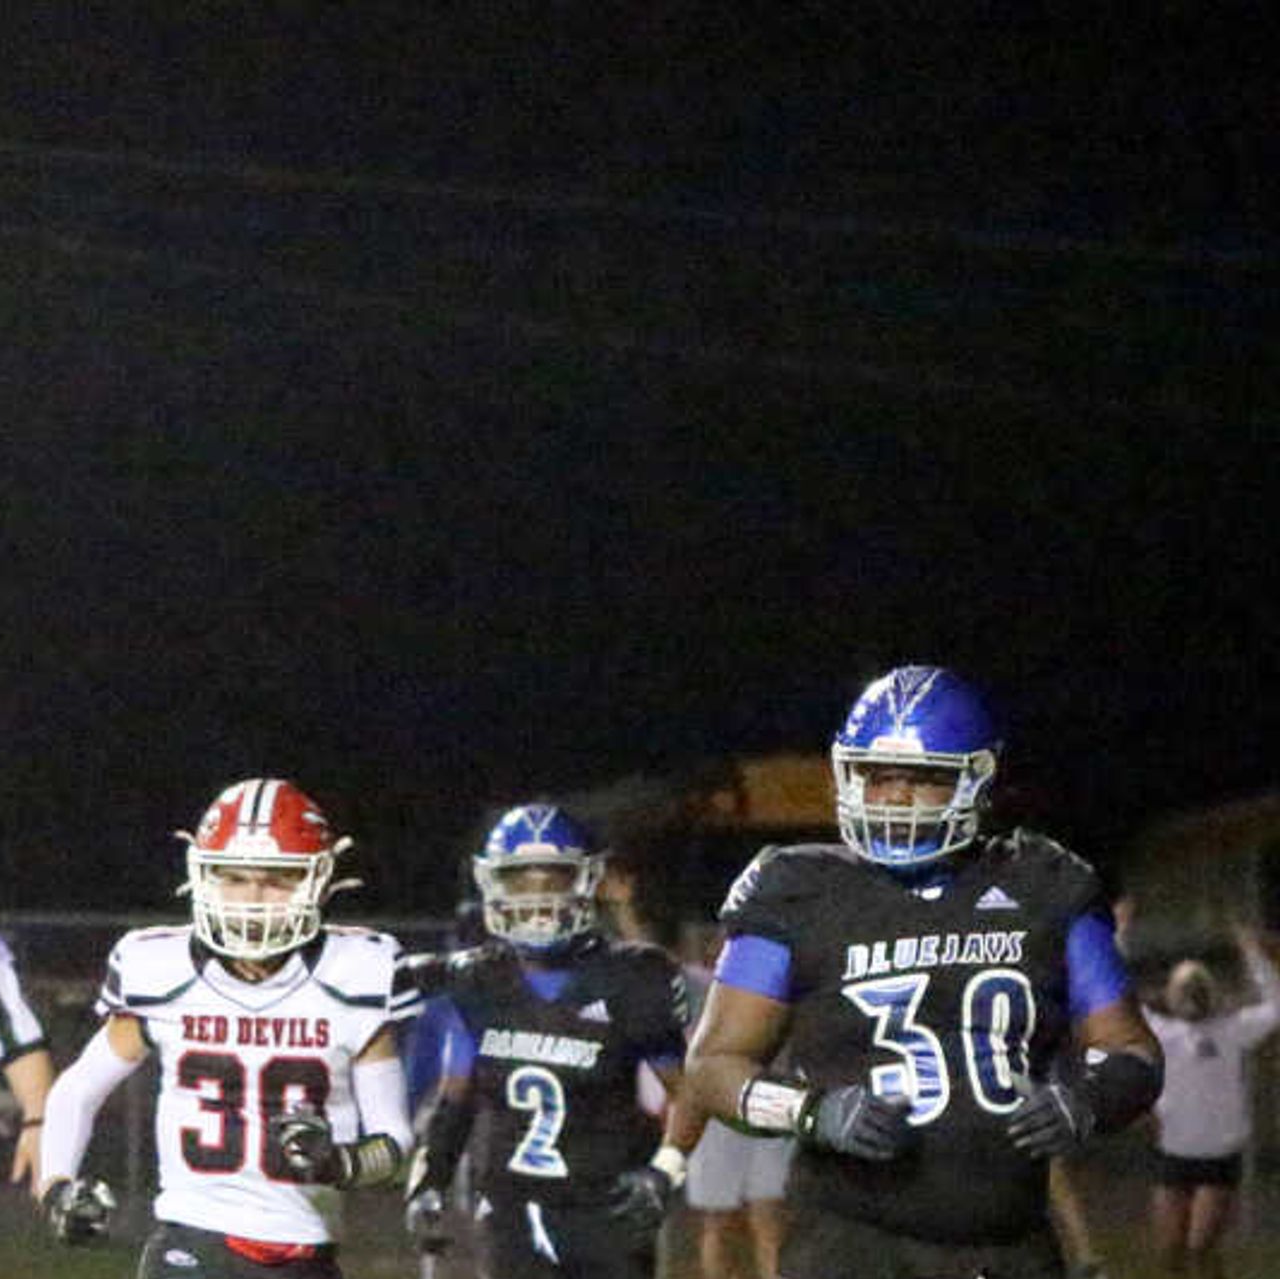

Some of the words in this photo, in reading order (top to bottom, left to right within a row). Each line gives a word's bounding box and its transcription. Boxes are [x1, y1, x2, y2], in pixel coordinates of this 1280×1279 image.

[180, 1014, 230, 1045] RED
[236, 1016, 331, 1049] DEVILS
[841, 967, 1037, 1126] 30
[507, 1065, 569, 1178] 2
